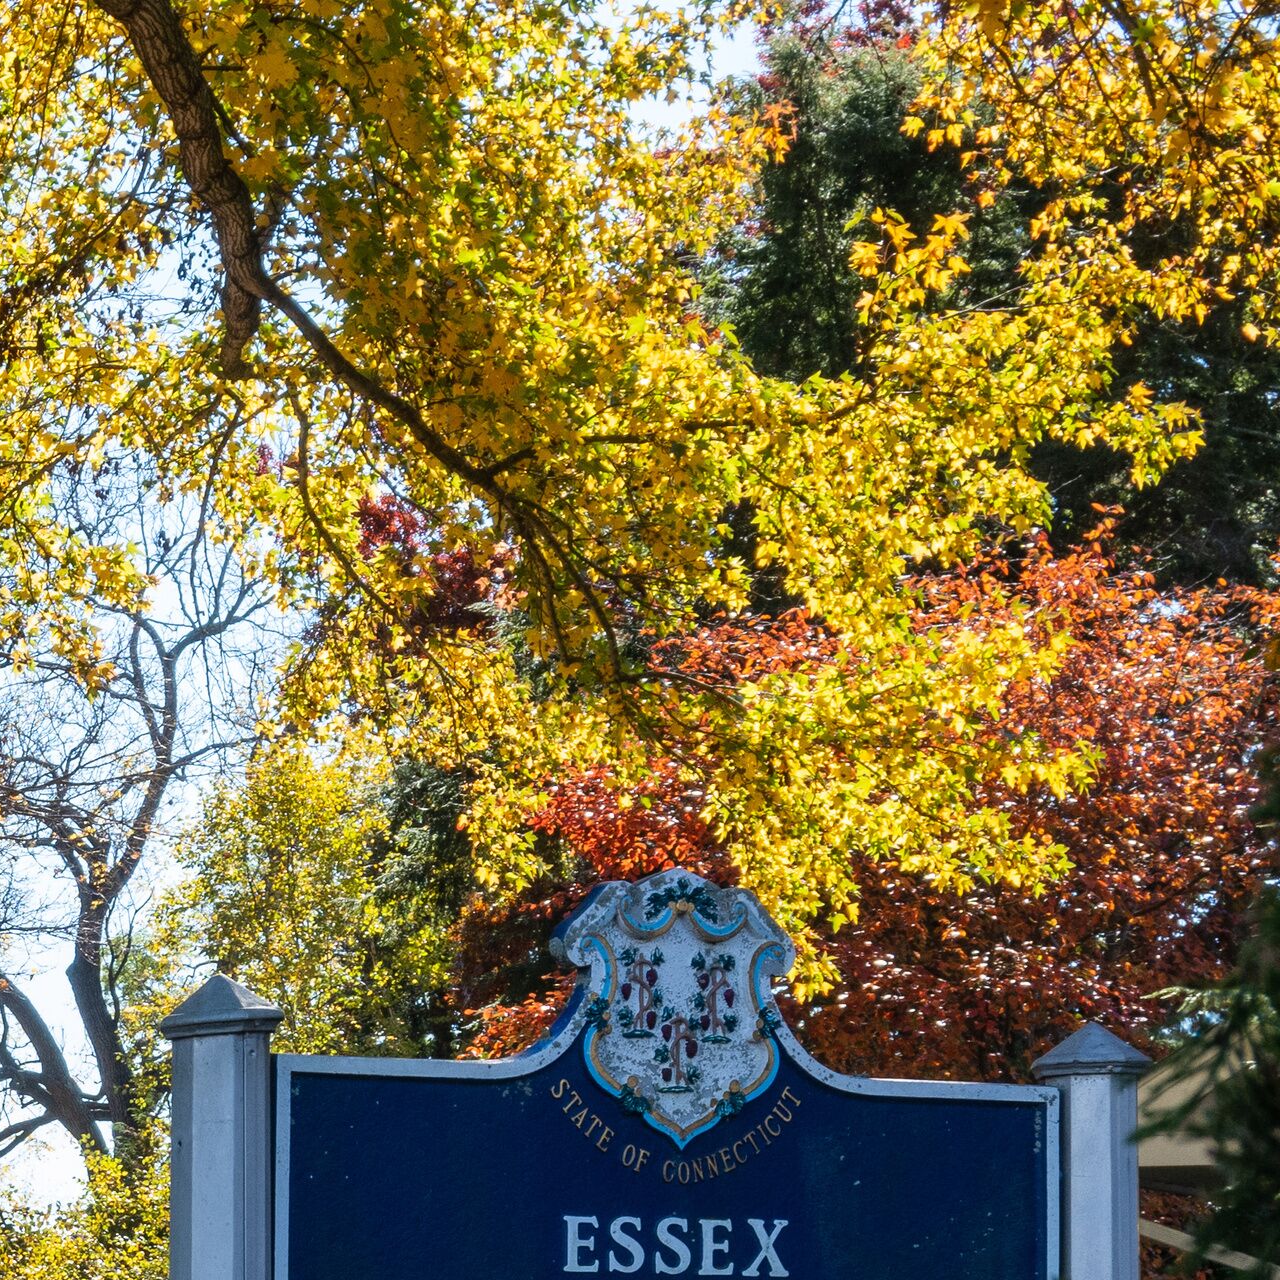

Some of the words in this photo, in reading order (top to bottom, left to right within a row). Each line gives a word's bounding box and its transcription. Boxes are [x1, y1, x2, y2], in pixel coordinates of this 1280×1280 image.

[550, 1078, 615, 1152] STATE
[621, 1144, 651, 1173] OF
[662, 1085, 802, 1184] CONNECTICUT
[562, 1215, 790, 1278] ESSEX
